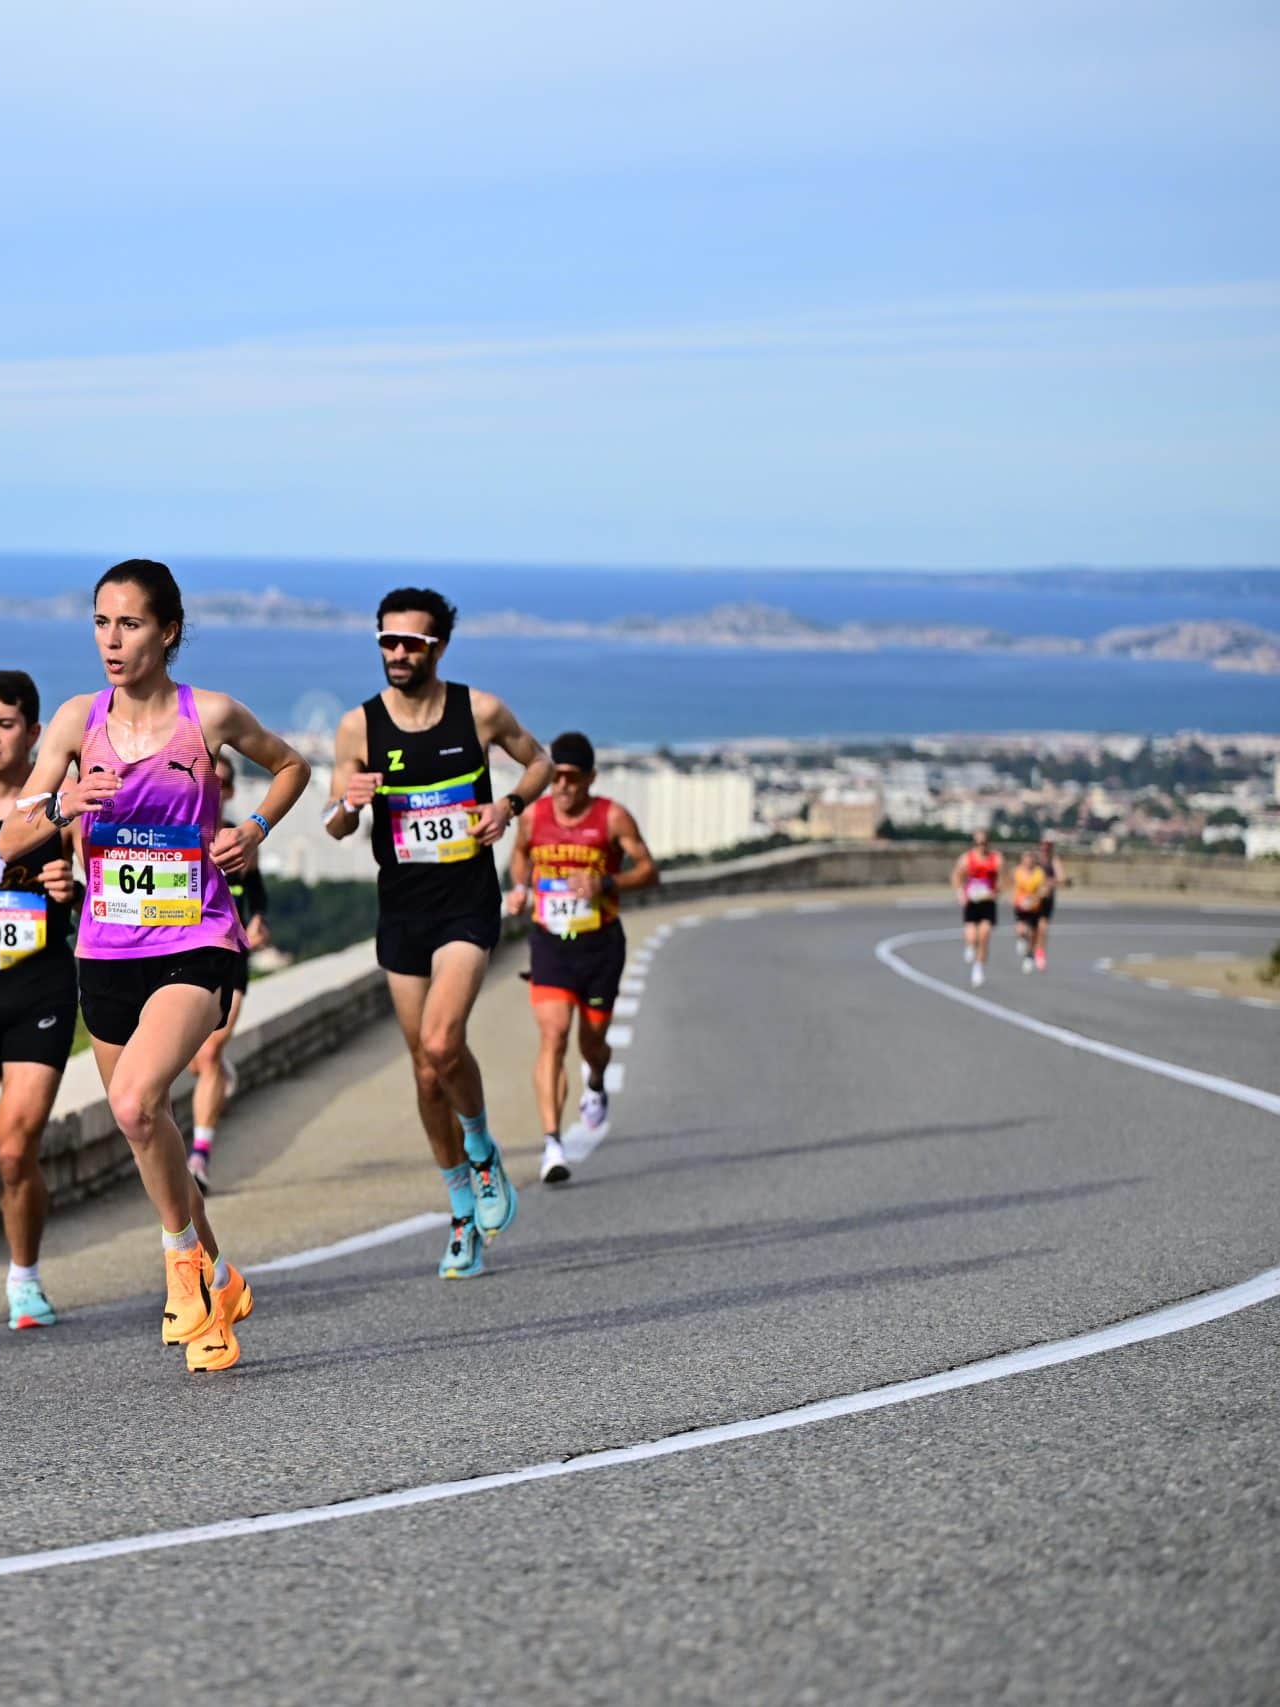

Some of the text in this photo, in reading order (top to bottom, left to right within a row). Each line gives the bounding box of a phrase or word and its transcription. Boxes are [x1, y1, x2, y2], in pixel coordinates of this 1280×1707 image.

[387, 749, 405, 772] Z
[133, 828, 153, 846] ici
[409, 818, 453, 842] 138
[104, 849, 183, 861] new balance
[119, 864, 155, 895] 64
